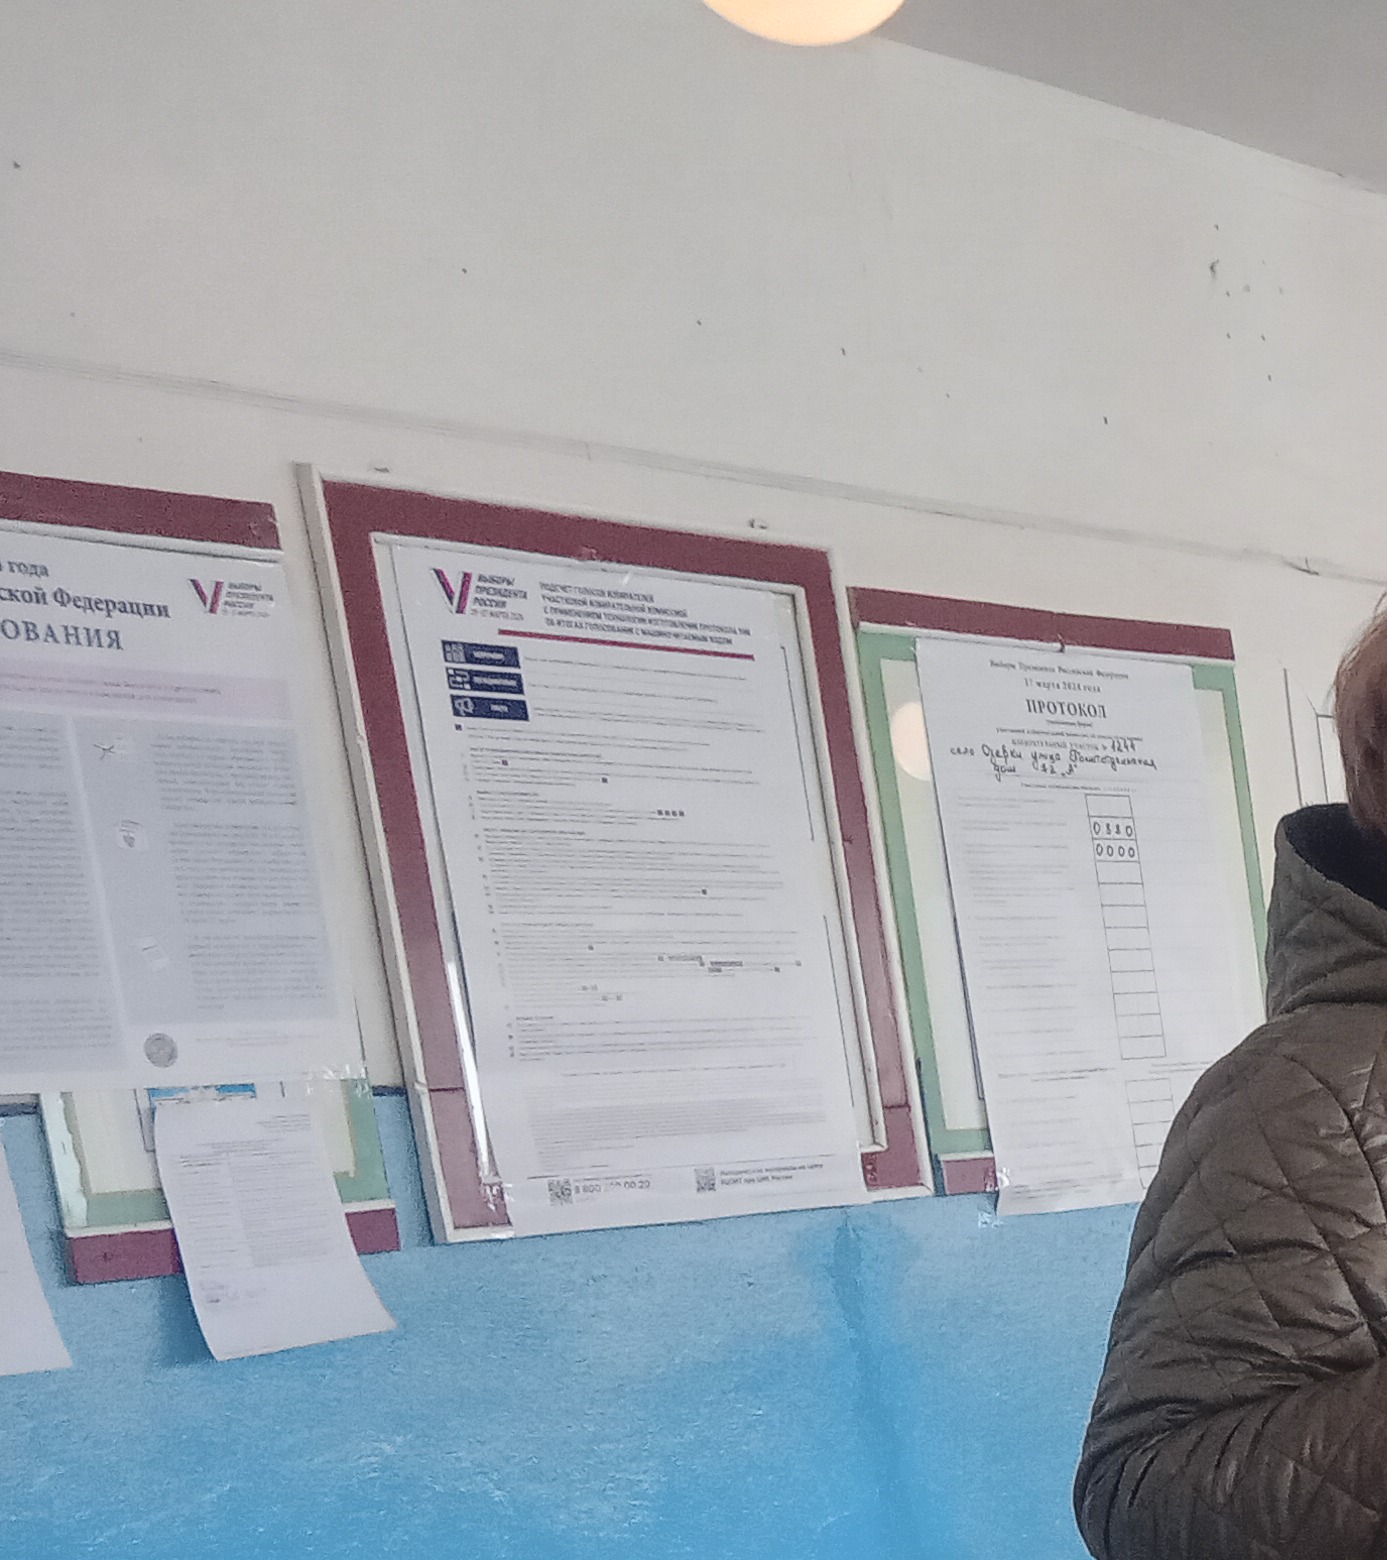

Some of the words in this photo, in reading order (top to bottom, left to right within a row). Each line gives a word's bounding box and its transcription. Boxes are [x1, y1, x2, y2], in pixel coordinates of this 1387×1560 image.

[8, 560, 50, 578] года
[52, 587, 172, 619] Федерации
[0, 619, 124, 651] ОВАНИЯ
[1025, 698, 1107, 719] ПРОТОКОЛ
